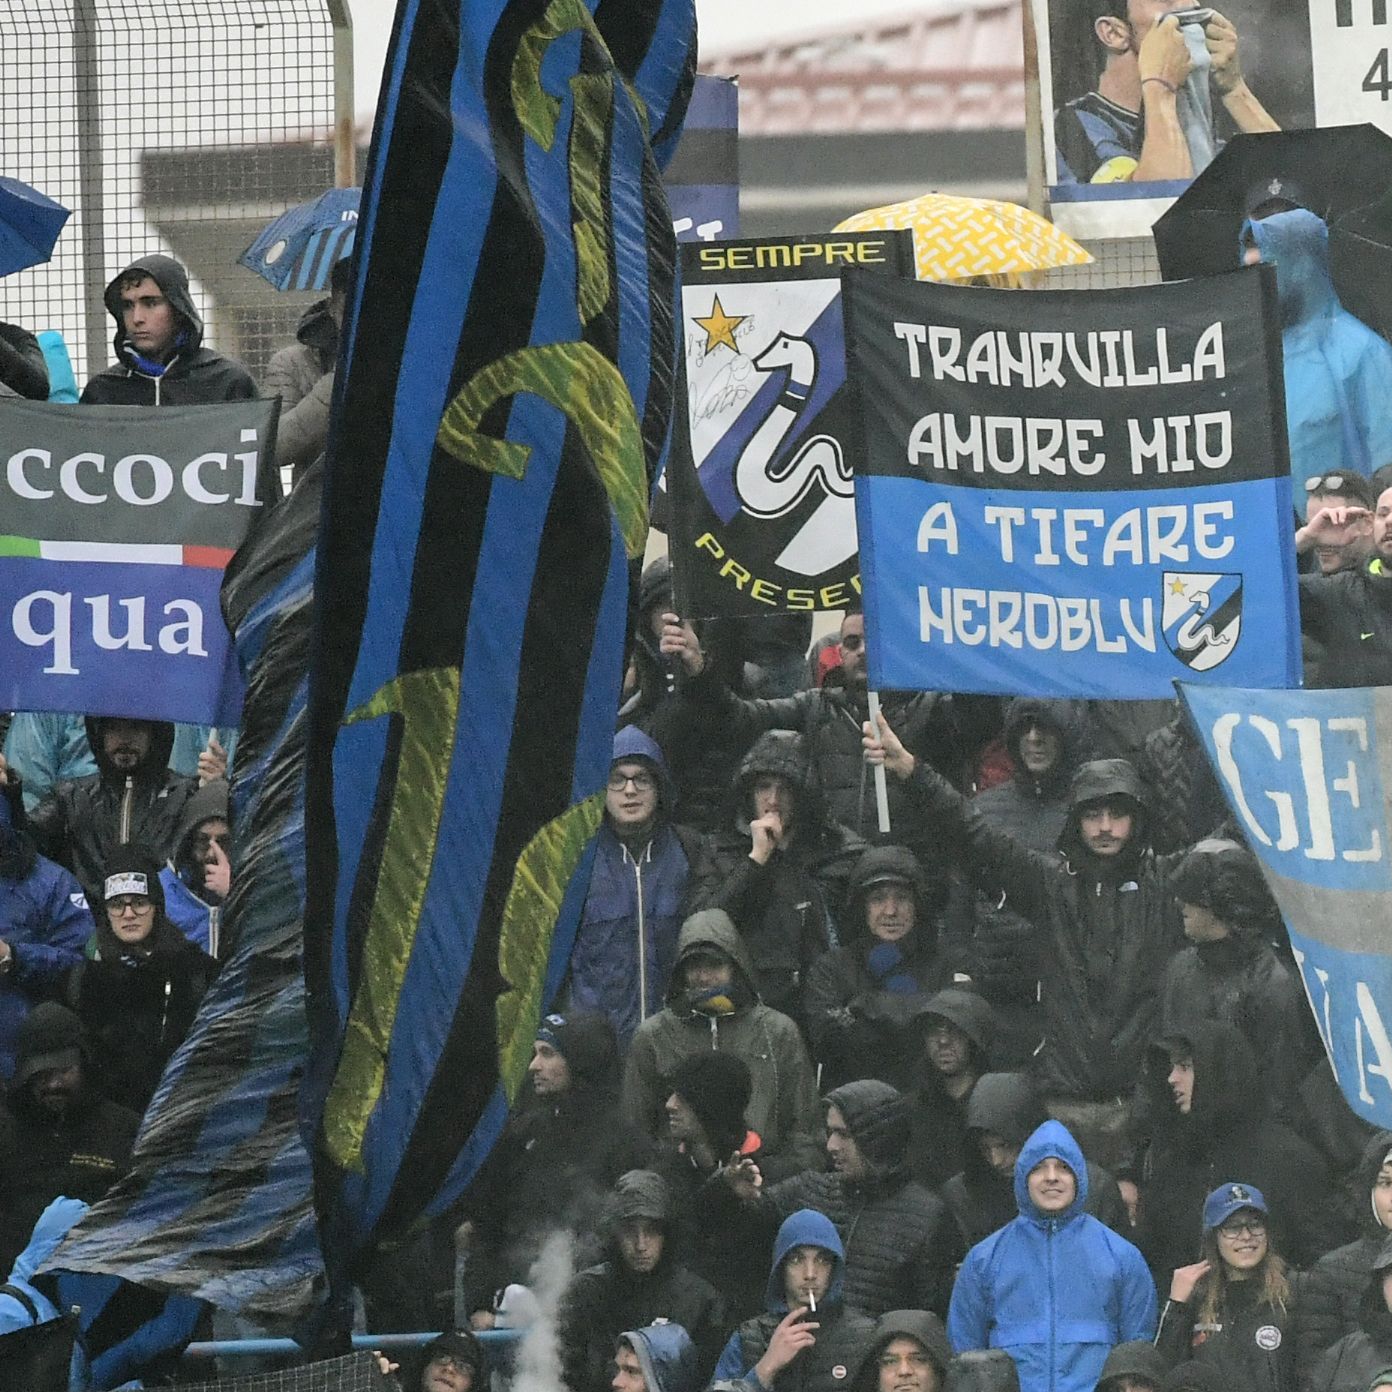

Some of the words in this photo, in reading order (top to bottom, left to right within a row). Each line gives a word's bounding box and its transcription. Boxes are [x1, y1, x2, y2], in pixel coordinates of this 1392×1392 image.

[1362, 46, 1392, 102] 4
[699, 240, 887, 272] SEMPRE
[907, 412, 1107, 476] AMORE
[1127, 410, 1233, 475] MIO
[916, 501, 960, 555] A
[984, 500, 1236, 567] TIFARE
[9, 586, 210, 676] qua
[917, 585, 1157, 654] NEROBLU
[1212, 711, 1383, 863] GE
